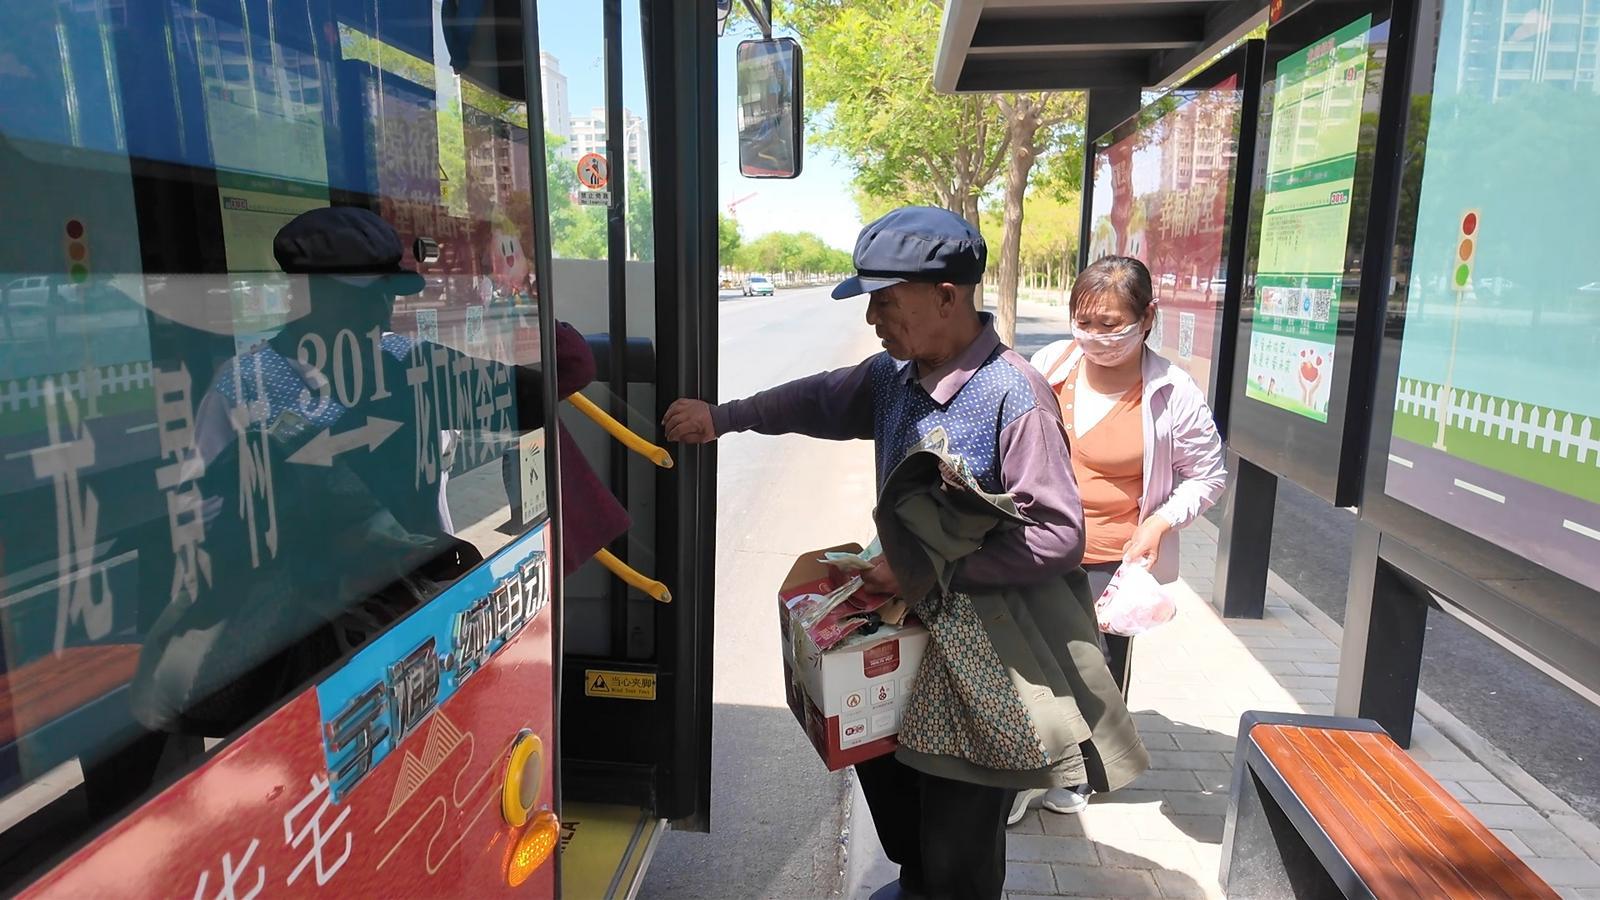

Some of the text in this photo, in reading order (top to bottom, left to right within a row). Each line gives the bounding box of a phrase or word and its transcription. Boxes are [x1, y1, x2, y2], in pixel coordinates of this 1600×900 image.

[297, 325, 391, 418] 301
[31, 340, 279, 656] 龙景村
[611, 675, 652, 689] 当心夹脚
